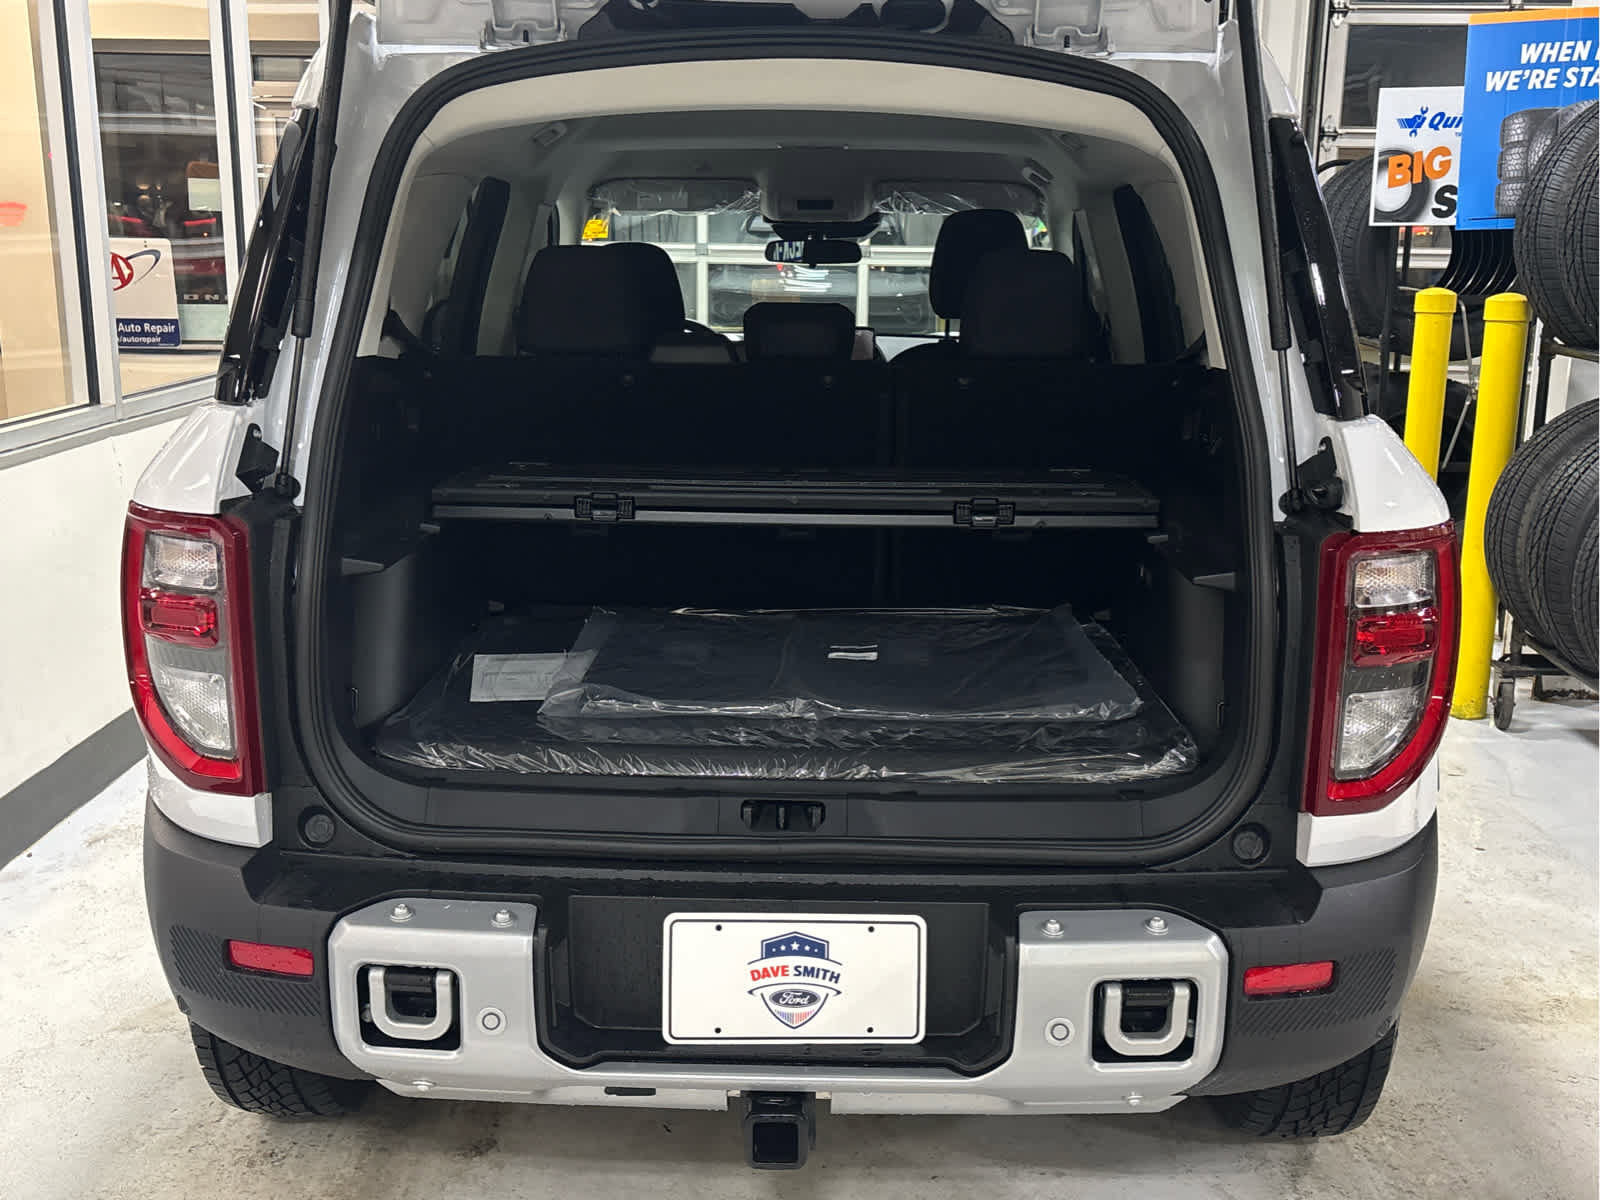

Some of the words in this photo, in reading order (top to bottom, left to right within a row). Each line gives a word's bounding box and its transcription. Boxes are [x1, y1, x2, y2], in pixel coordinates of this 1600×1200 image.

[1520, 40, 1593, 64] WHEN
[1387, 145, 1452, 189] BIG
[118, 322, 142, 333] Auto
[143, 322, 176, 335] Repair
[750, 965, 790, 982] DAVE
[793, 965, 841, 984] SMITH
[779, 991, 810, 1005] Ford
